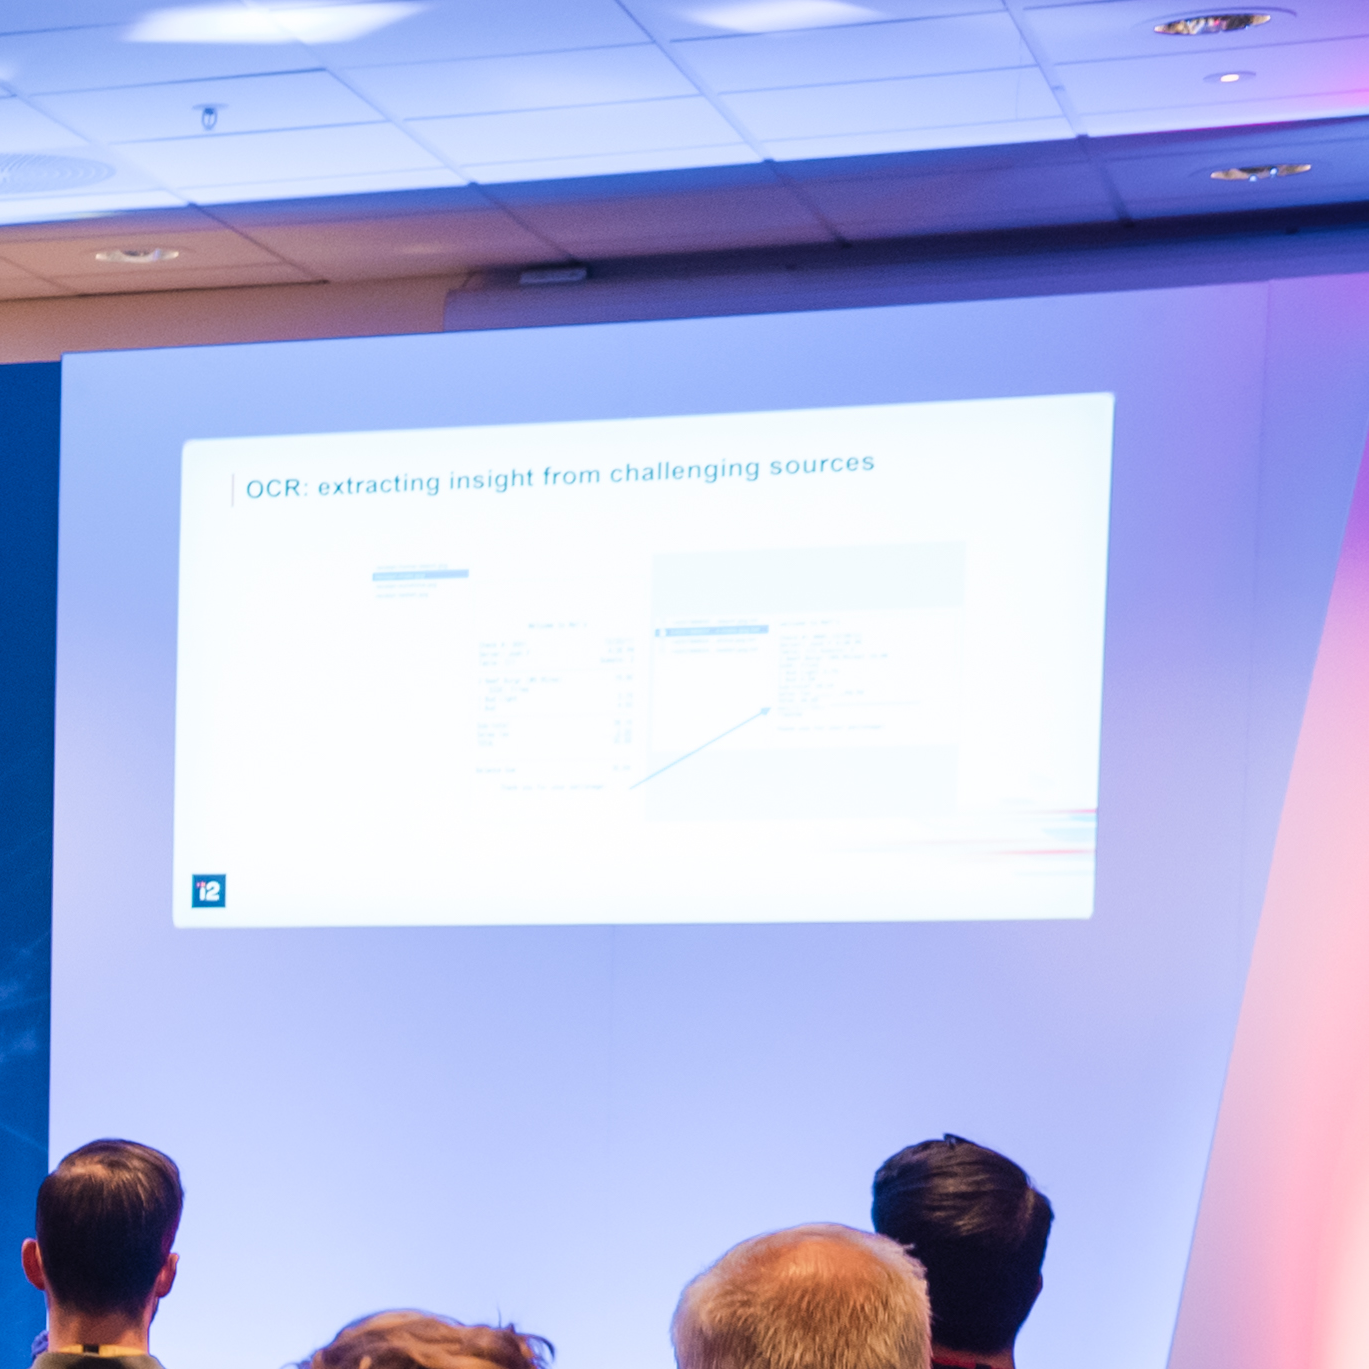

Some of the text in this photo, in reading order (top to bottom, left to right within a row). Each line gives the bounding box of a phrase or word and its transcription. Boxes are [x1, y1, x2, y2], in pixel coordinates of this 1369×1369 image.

[246, 456, 875, 499] OCR: extracting insight from challenging sources
